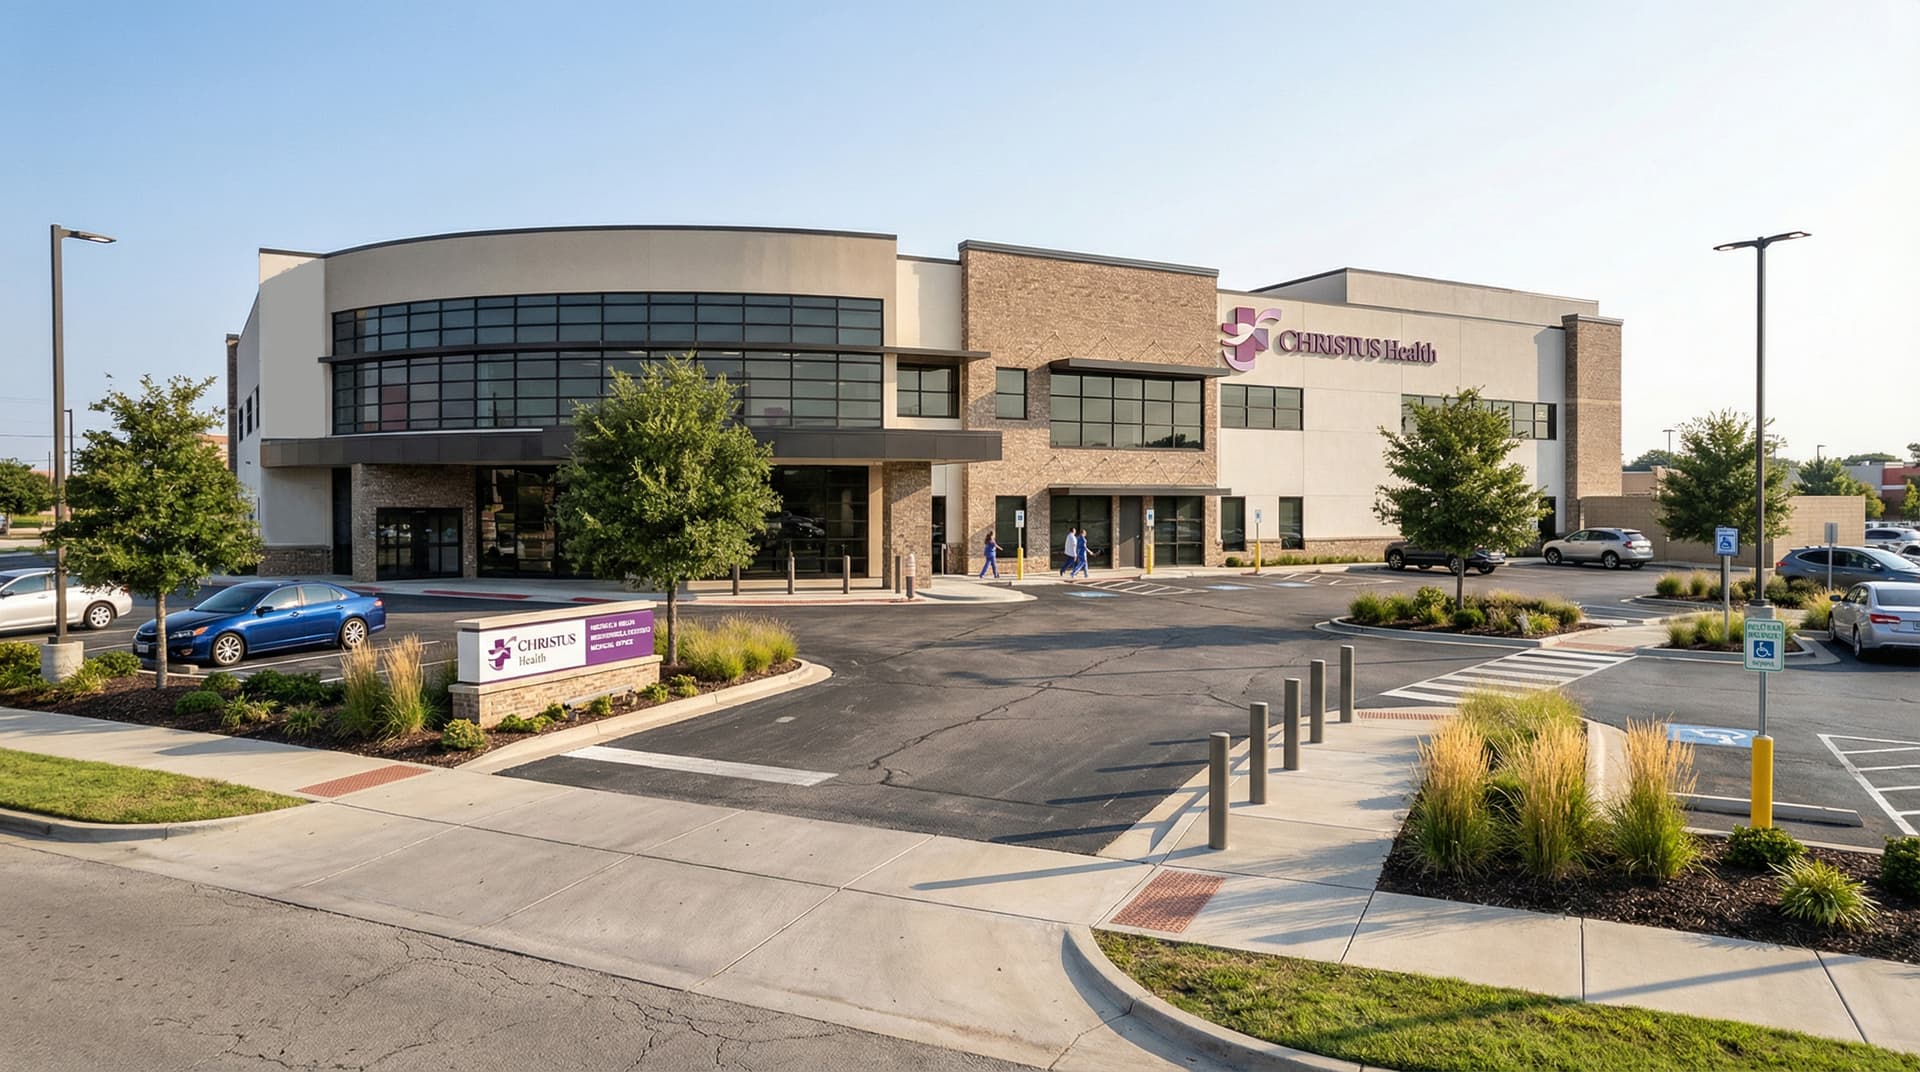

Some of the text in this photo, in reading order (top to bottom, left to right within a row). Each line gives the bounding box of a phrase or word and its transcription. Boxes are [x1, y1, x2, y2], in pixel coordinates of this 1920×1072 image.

[1279, 330, 1438, 364] CHRISTUS Health
[518, 633, 577, 652] CHRISTUS
[519, 653, 547, 667] Health
